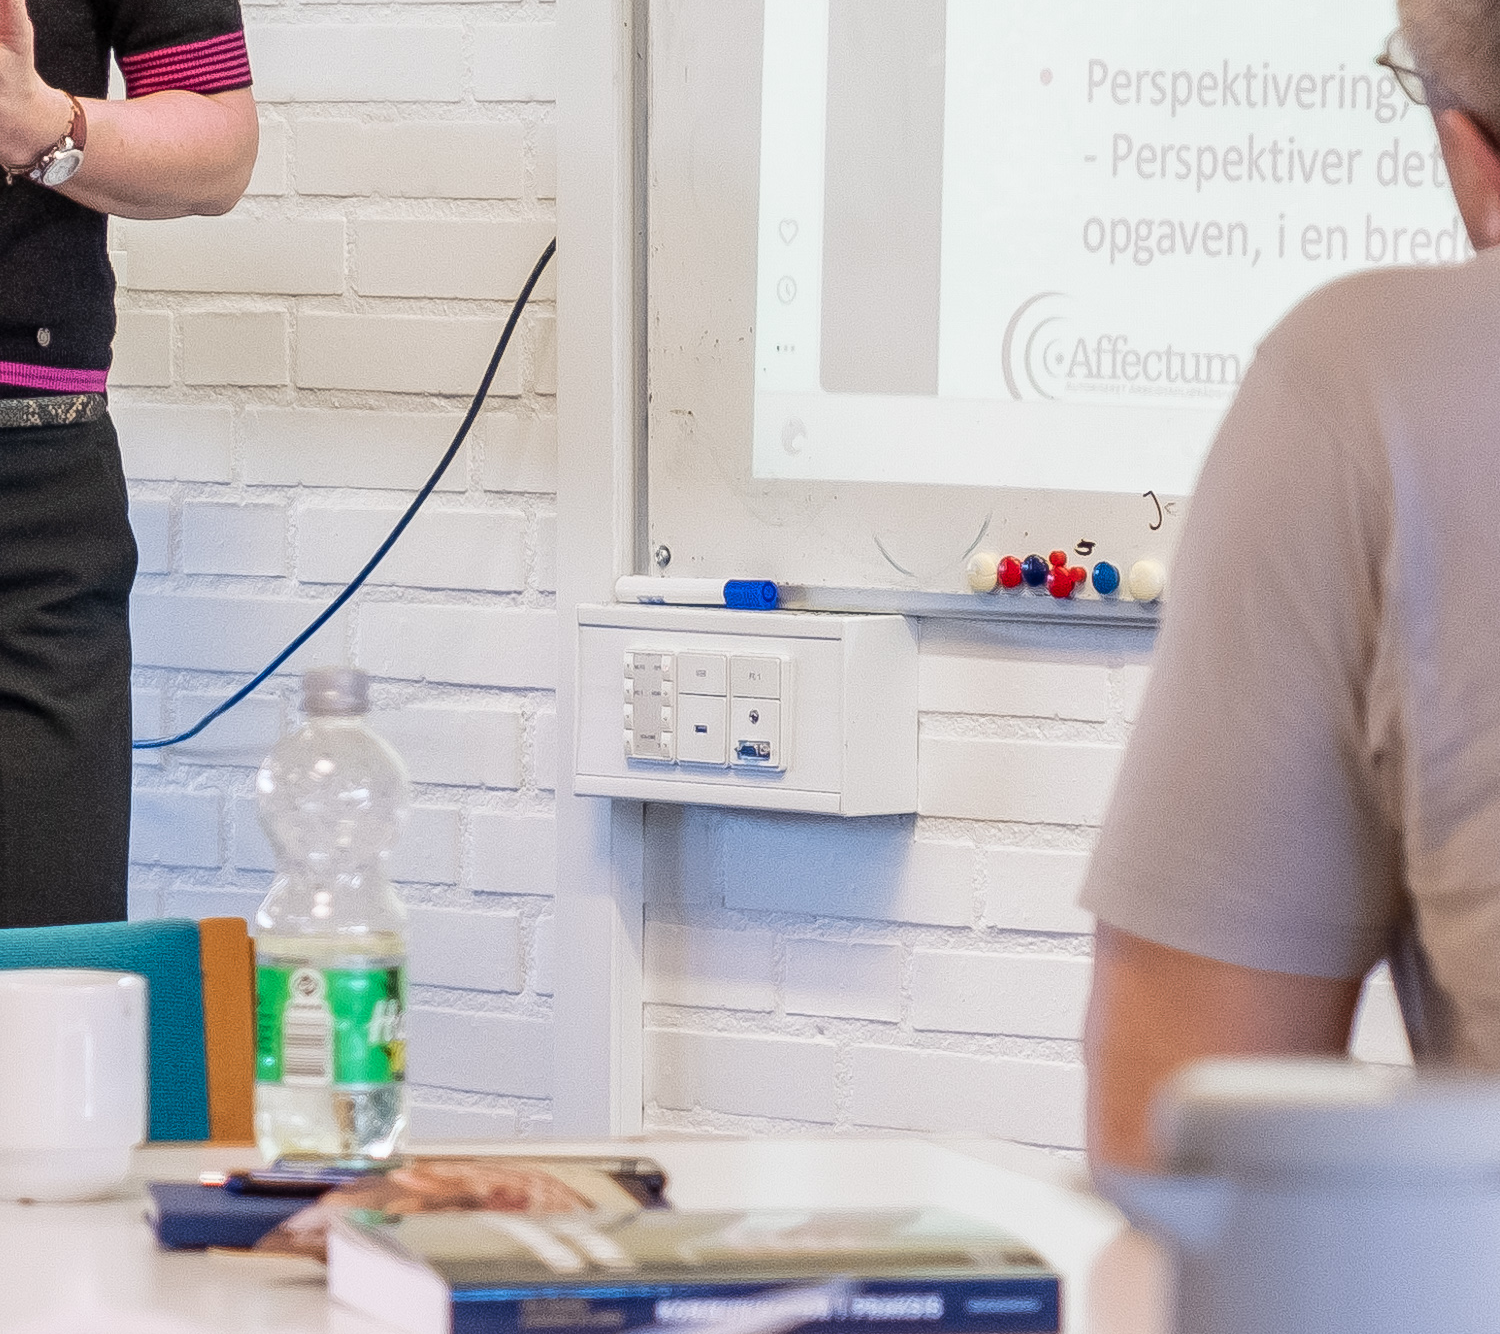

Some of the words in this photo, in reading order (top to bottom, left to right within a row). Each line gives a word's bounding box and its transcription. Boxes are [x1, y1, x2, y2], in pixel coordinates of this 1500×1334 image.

[1110, 132, 1362, 191] Perspektiver
[1375, 138, 1446, 188] det
[1082, 213, 1260, 266] opgaven,
[1299, 219, 1348, 262] en
[1364, 213, 1470, 263] bred
[1066, 333, 1242, 385] Affectum
